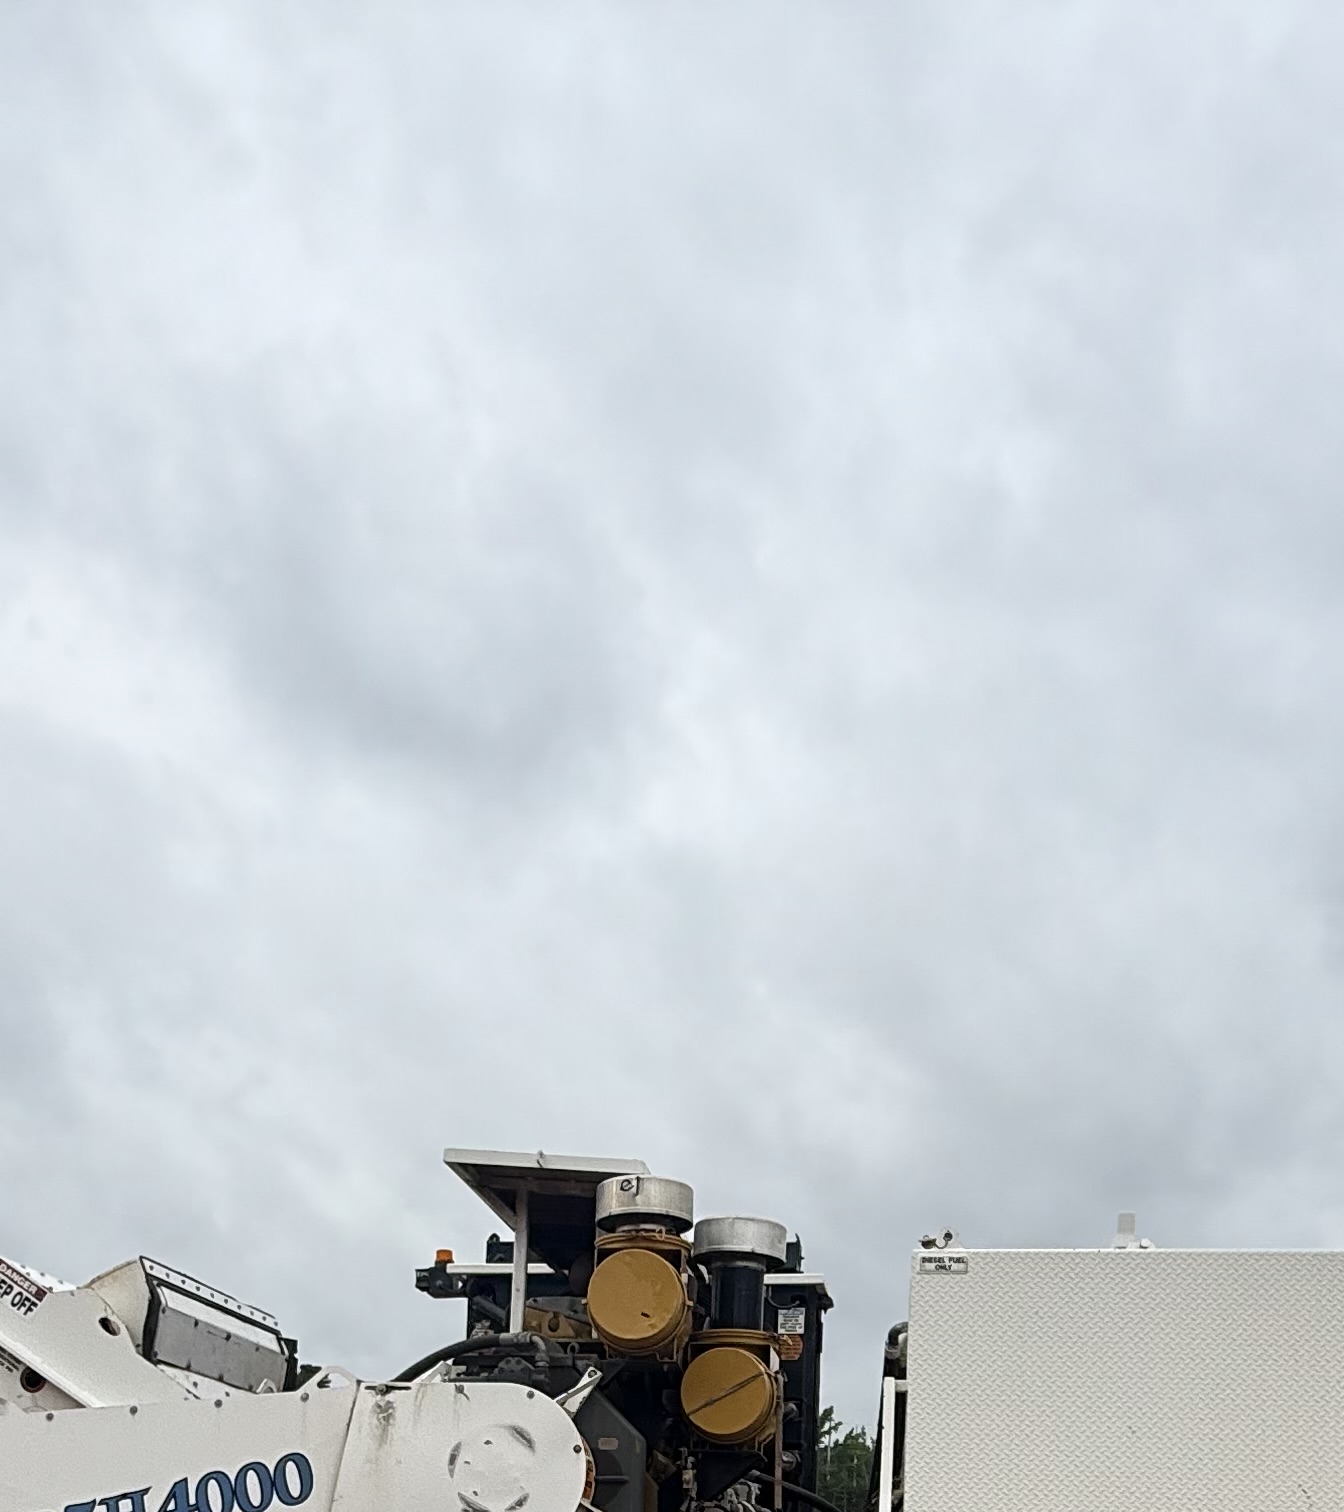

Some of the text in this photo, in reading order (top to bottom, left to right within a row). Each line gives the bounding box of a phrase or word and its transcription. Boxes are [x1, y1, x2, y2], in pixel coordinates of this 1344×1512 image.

[921, 1256, 967, 1264] DIESEL FUEL
[934, 1263, 953, 1271] ONLY
[10, 1291, 39, 1316] OFF
